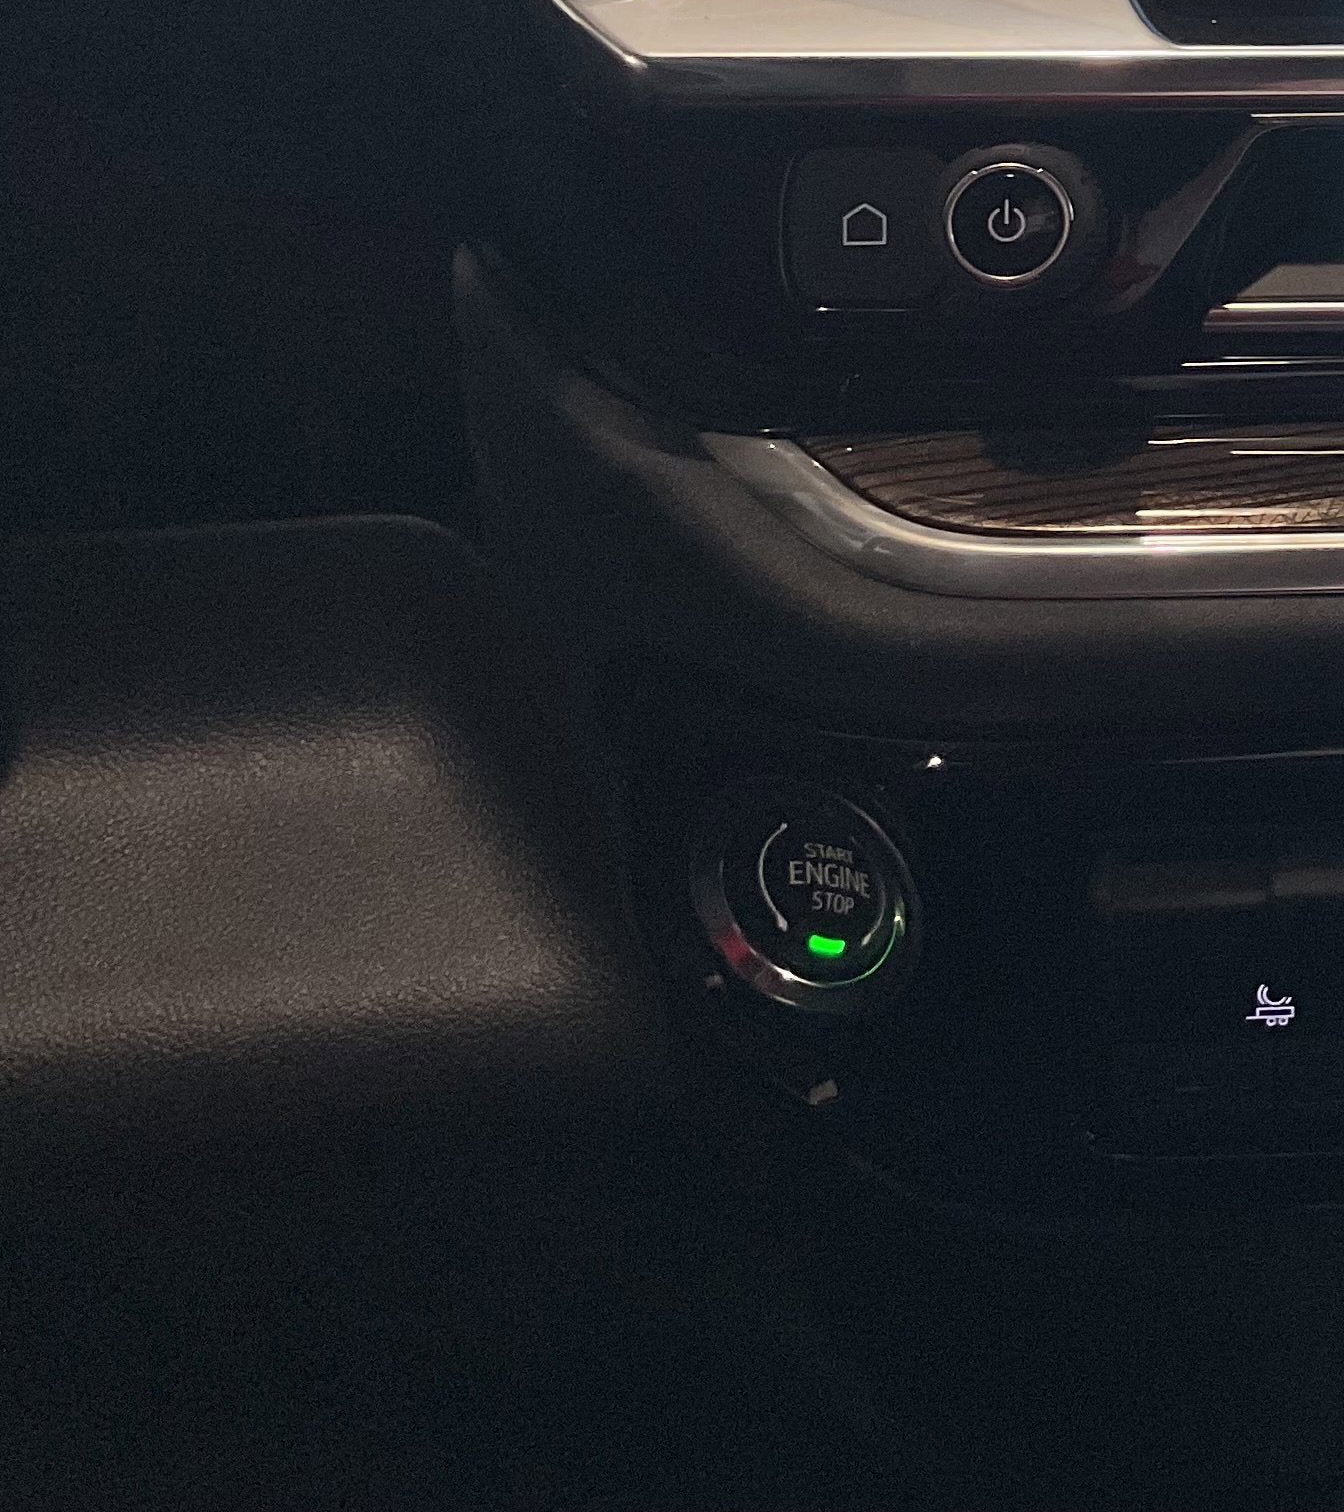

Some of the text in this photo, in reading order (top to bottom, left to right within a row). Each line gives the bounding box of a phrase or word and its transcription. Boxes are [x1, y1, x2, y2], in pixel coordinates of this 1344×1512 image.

[803, 841, 855, 864] START
[788, 860, 871, 900] ENGINE
[811, 889, 856, 916] STOP
